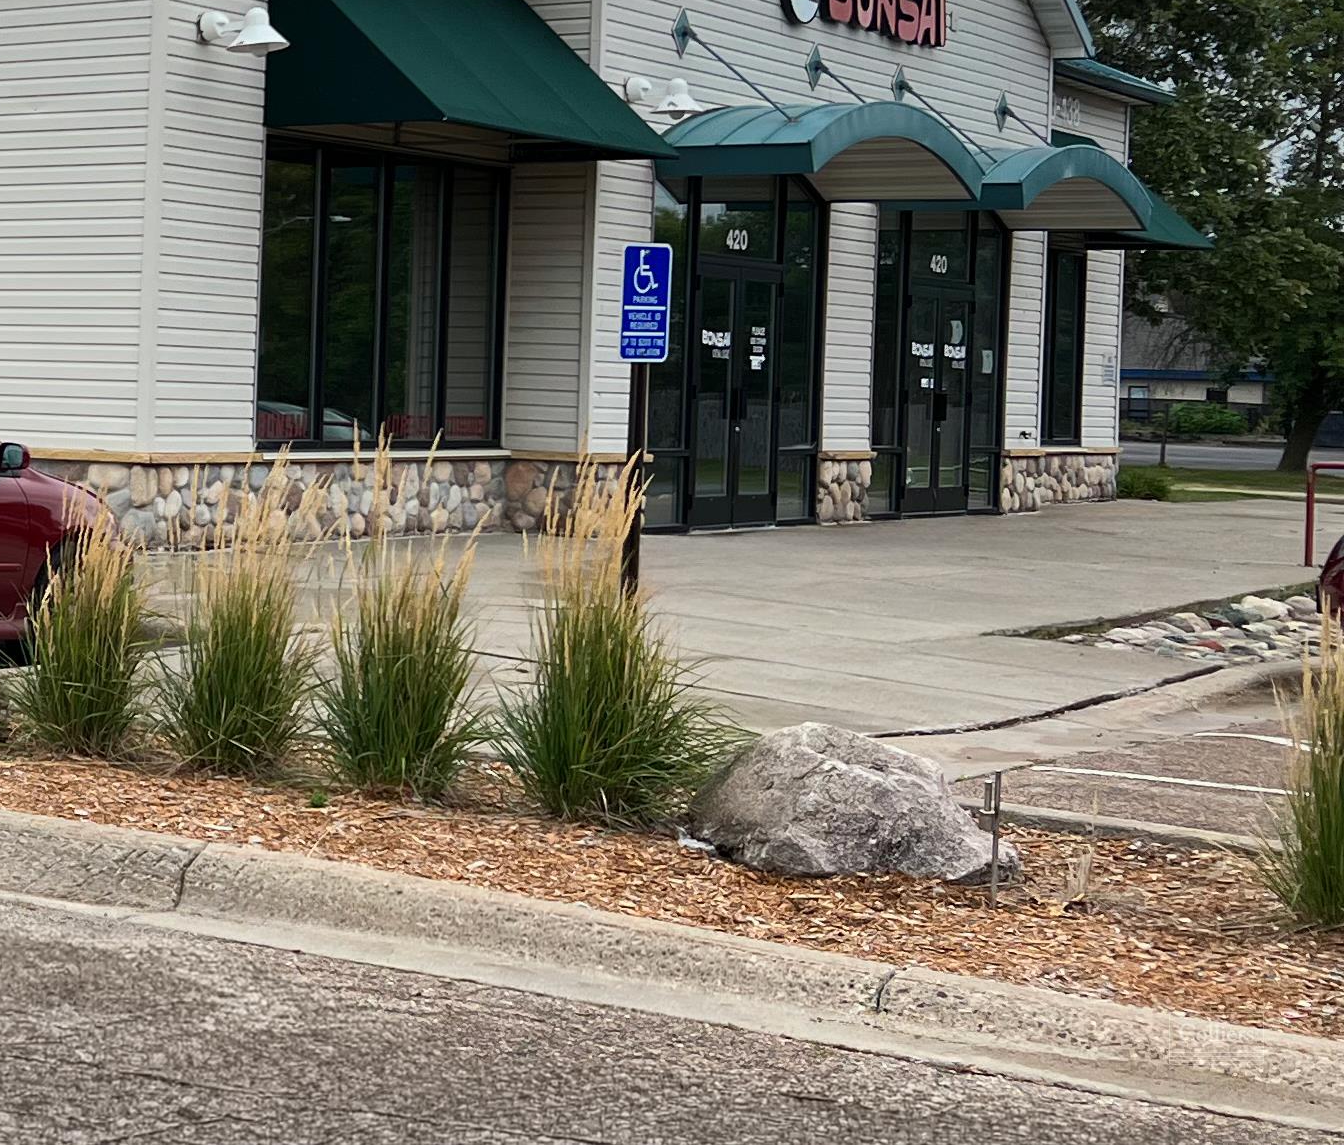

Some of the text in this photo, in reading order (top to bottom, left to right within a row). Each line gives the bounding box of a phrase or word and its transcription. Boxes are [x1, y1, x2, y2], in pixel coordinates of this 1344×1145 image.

[726, 229, 748, 250] 420
[930, 255, 948, 274] 420
[632, 296, 658, 304] PARKING
[628, 312, 652, 321] VEHICLE
